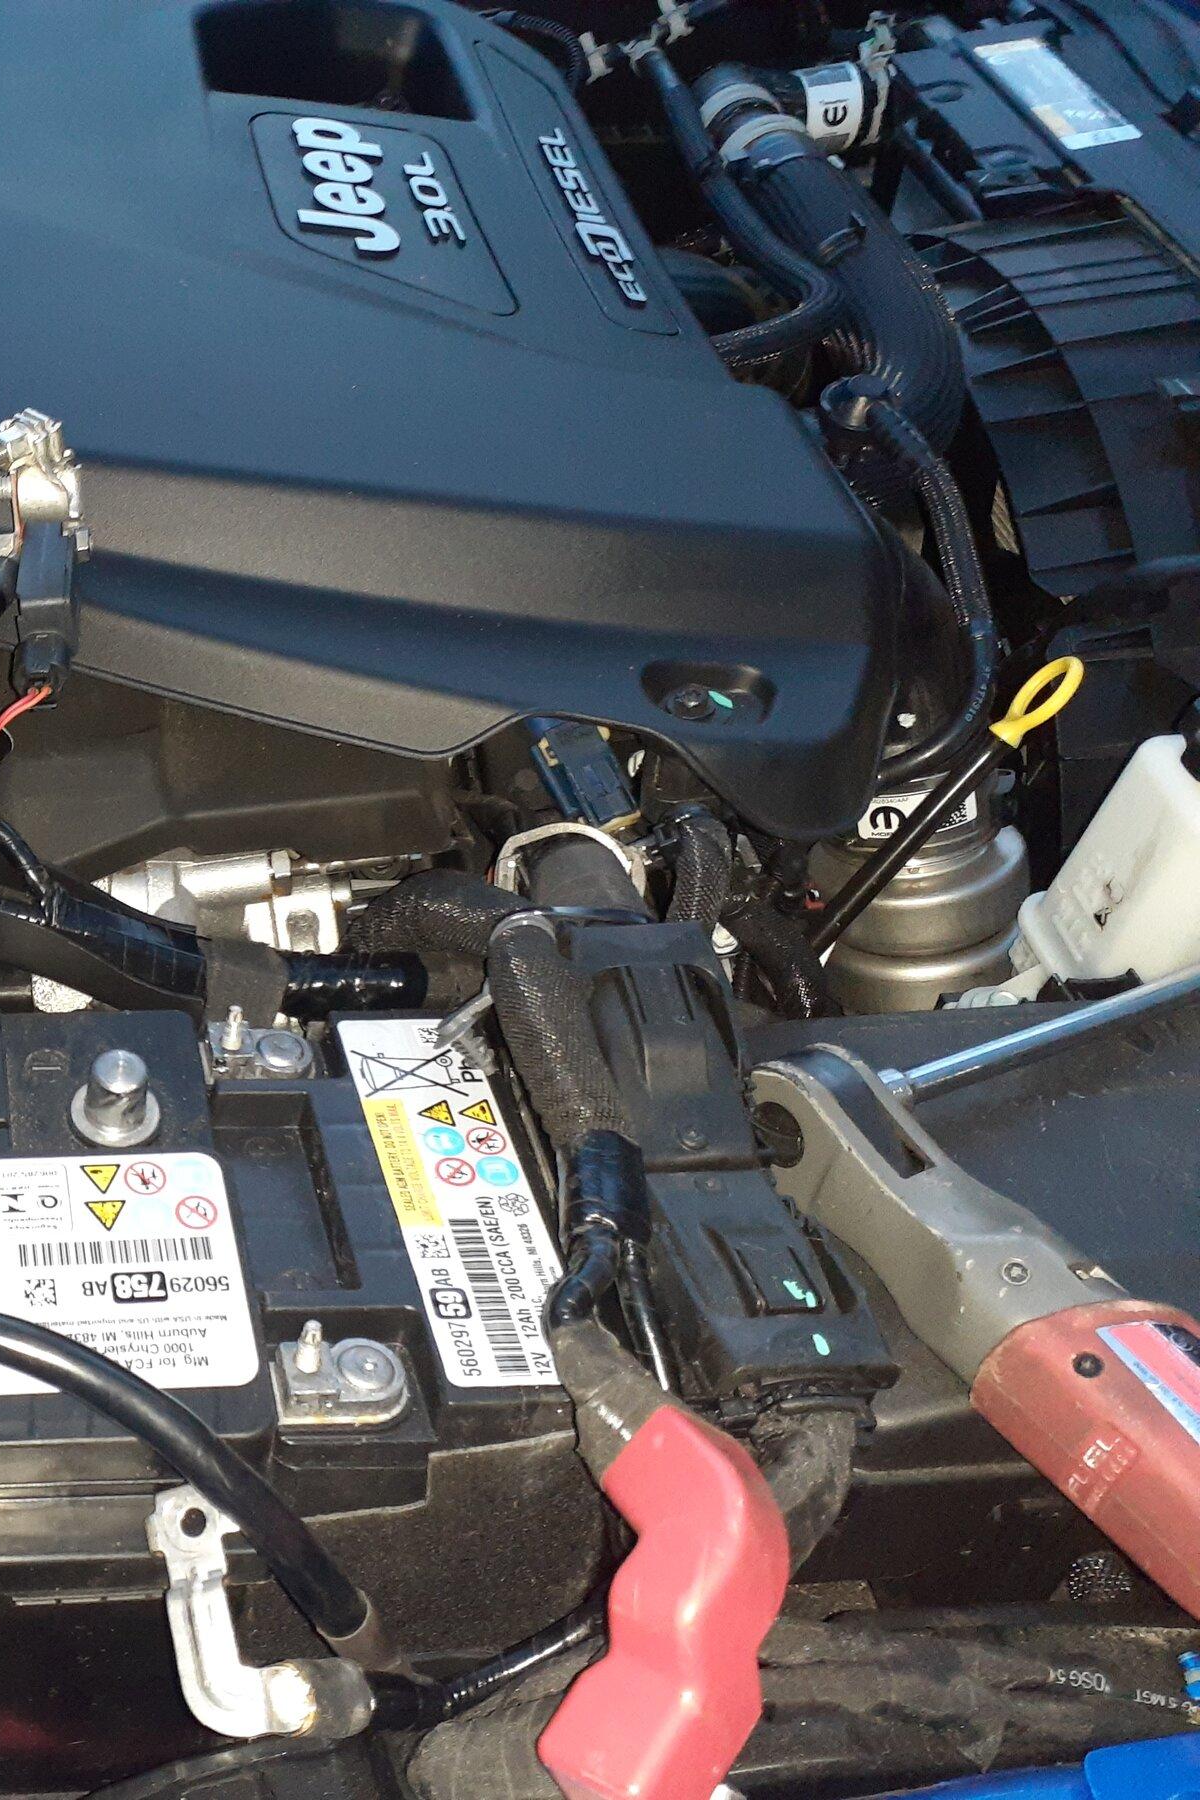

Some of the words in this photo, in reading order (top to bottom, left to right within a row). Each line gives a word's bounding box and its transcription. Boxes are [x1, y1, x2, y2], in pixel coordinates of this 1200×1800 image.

[291, 116, 400, 252] Jeep
[496, 1251, 516, 1274] CCA
[113, 1273, 166, 1299] 758
[170, 1276, 229, 1293] 56029
[431, 1268, 453, 1287] AB
[82, 1281, 107, 1296] AB
[507, 1278, 525, 1300] 200
[517, 1309, 539, 1338] 12Ah
[101, 1332, 116, 1341] MI
[158, 1328, 207, 1338] Auburn
[102, 1343, 159, 1355] Chrysler
[163, 1342, 193, 1353] 1000
[124, 1358, 152, 1371] FCA
[158, 1357, 175, 1366] for
[531, 1352, 552, 1376] 12V
